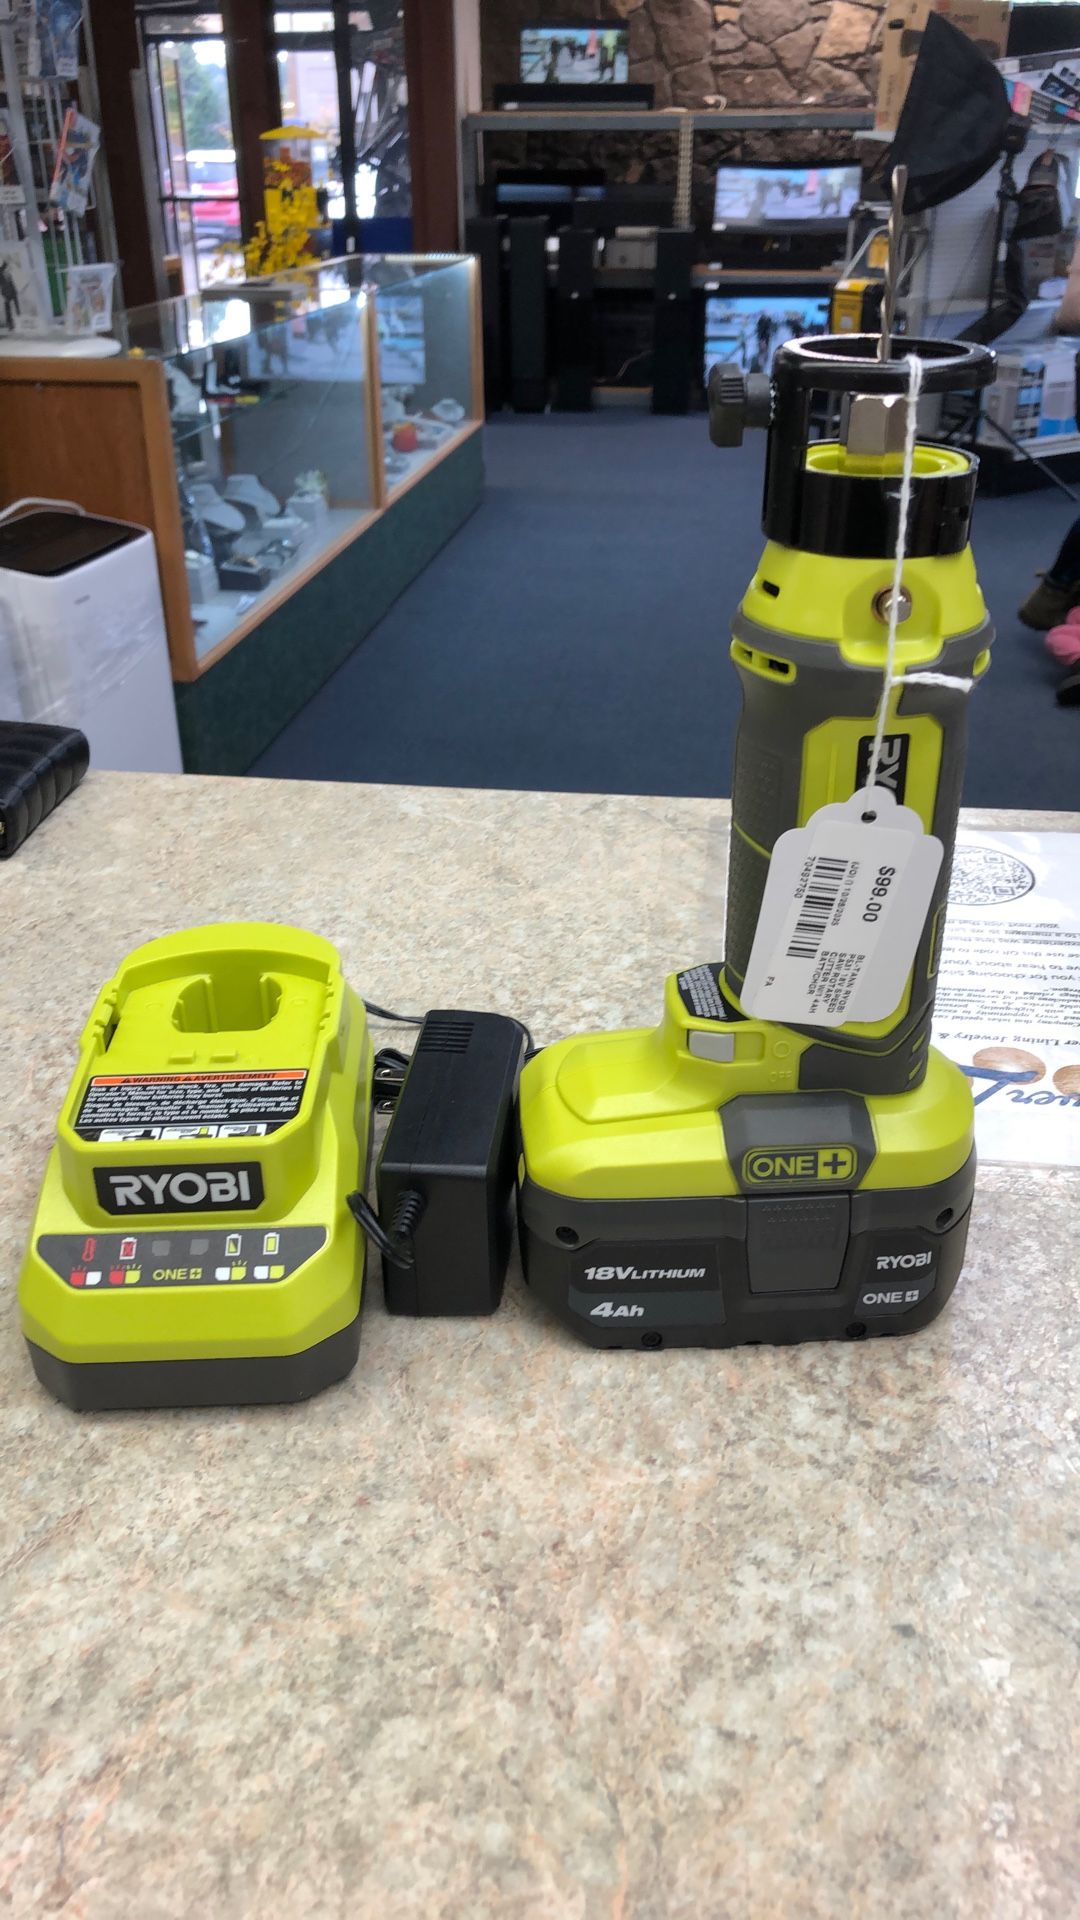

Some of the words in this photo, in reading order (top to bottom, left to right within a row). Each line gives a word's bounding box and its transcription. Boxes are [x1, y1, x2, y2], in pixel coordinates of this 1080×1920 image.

[794, 856, 816, 898] 70492750
[863, 865, 897, 923] $99.00
[821, 951, 839, 983] CUTTER
[835, 952, 848, 971] SAW
[763, 975, 776, 987] FA
[837, 973, 849, 987] 18V
[967, 970, 1026, 979] choosing
[823, 972, 840, 1004] ROTARY
[808, 997, 820, 1014] 4AH
[826, 988, 843, 1013] SPEED
[836, 990, 852, 1013] RYOBI
[938, 1032, 950, 1040] &
[954, 1032, 1008, 1042] Jewelry
[1012, 1035, 1059, 1046] Lining
[195, 1073, 277, 1081] AVERTISSEMENT
[109, 1170, 251, 1207] RYOBI
[876, 1251, 932, 1270] RYOBI
[590, 1301, 645, 1318] 4Ah
